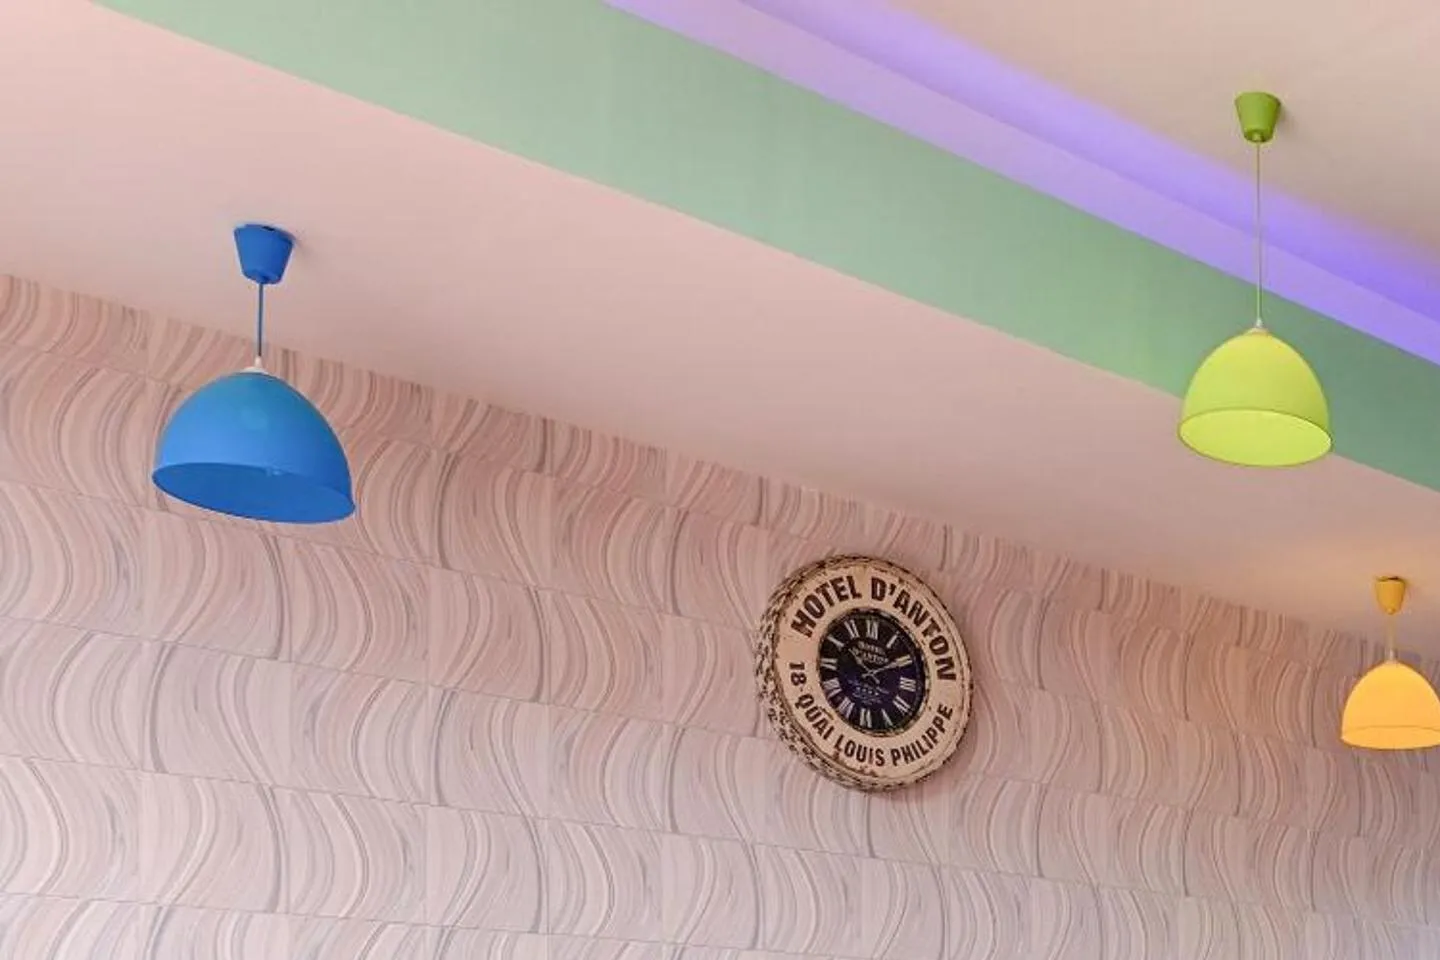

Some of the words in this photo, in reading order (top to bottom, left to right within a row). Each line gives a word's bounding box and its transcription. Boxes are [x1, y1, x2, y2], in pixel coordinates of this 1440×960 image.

[791, 575, 863, 638] HOTEL
[871, 576, 957, 681] D'ANTON
[794, 693, 835, 740] QUAI
[834, 734, 885, 767] LOUIS
[890, 702, 953, 767] PHILIPPE
